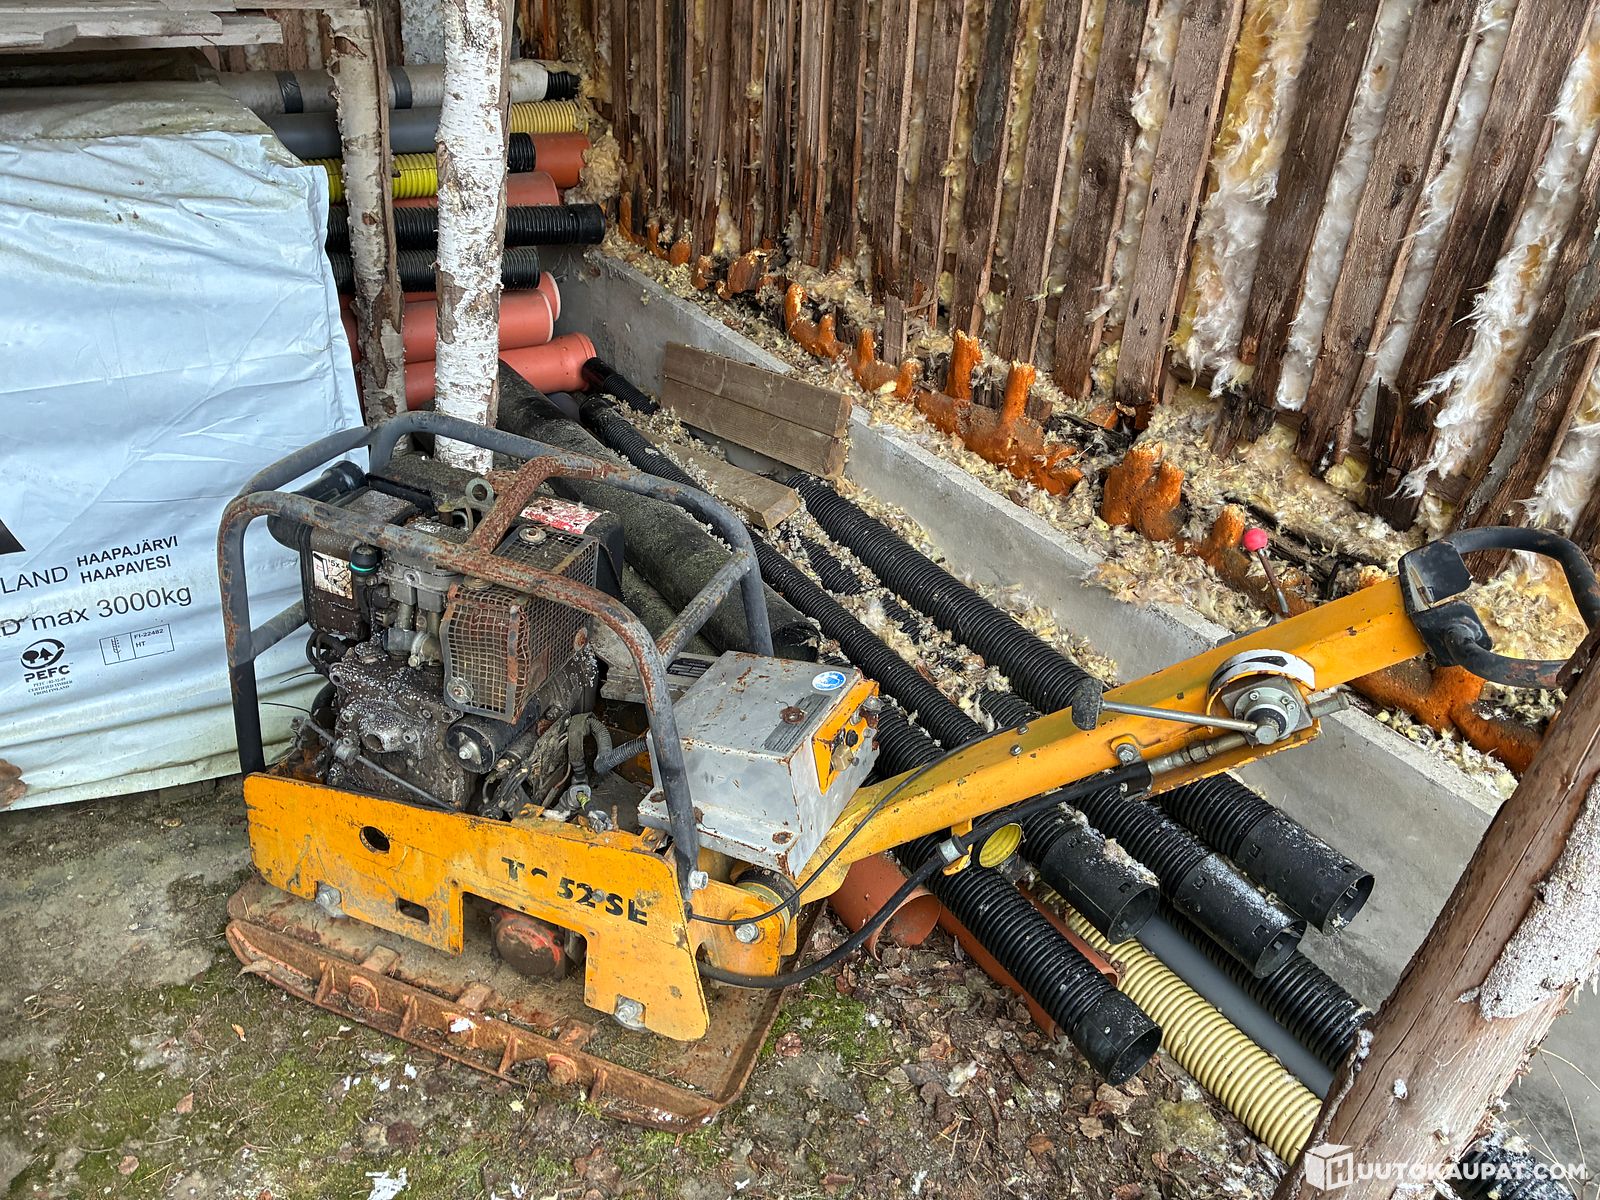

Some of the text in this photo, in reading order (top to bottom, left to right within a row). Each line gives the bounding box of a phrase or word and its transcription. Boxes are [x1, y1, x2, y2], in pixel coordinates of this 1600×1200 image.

[77, 535, 178, 567] HAAPAJÄRVI
[0, 566, 68, 594] LAND
[80, 554, 172, 584] HAAPAVESI
[32, 607, 90, 631] max
[96, 586, 192, 619] 3000kg
[24, 664, 70, 683] PEFC
